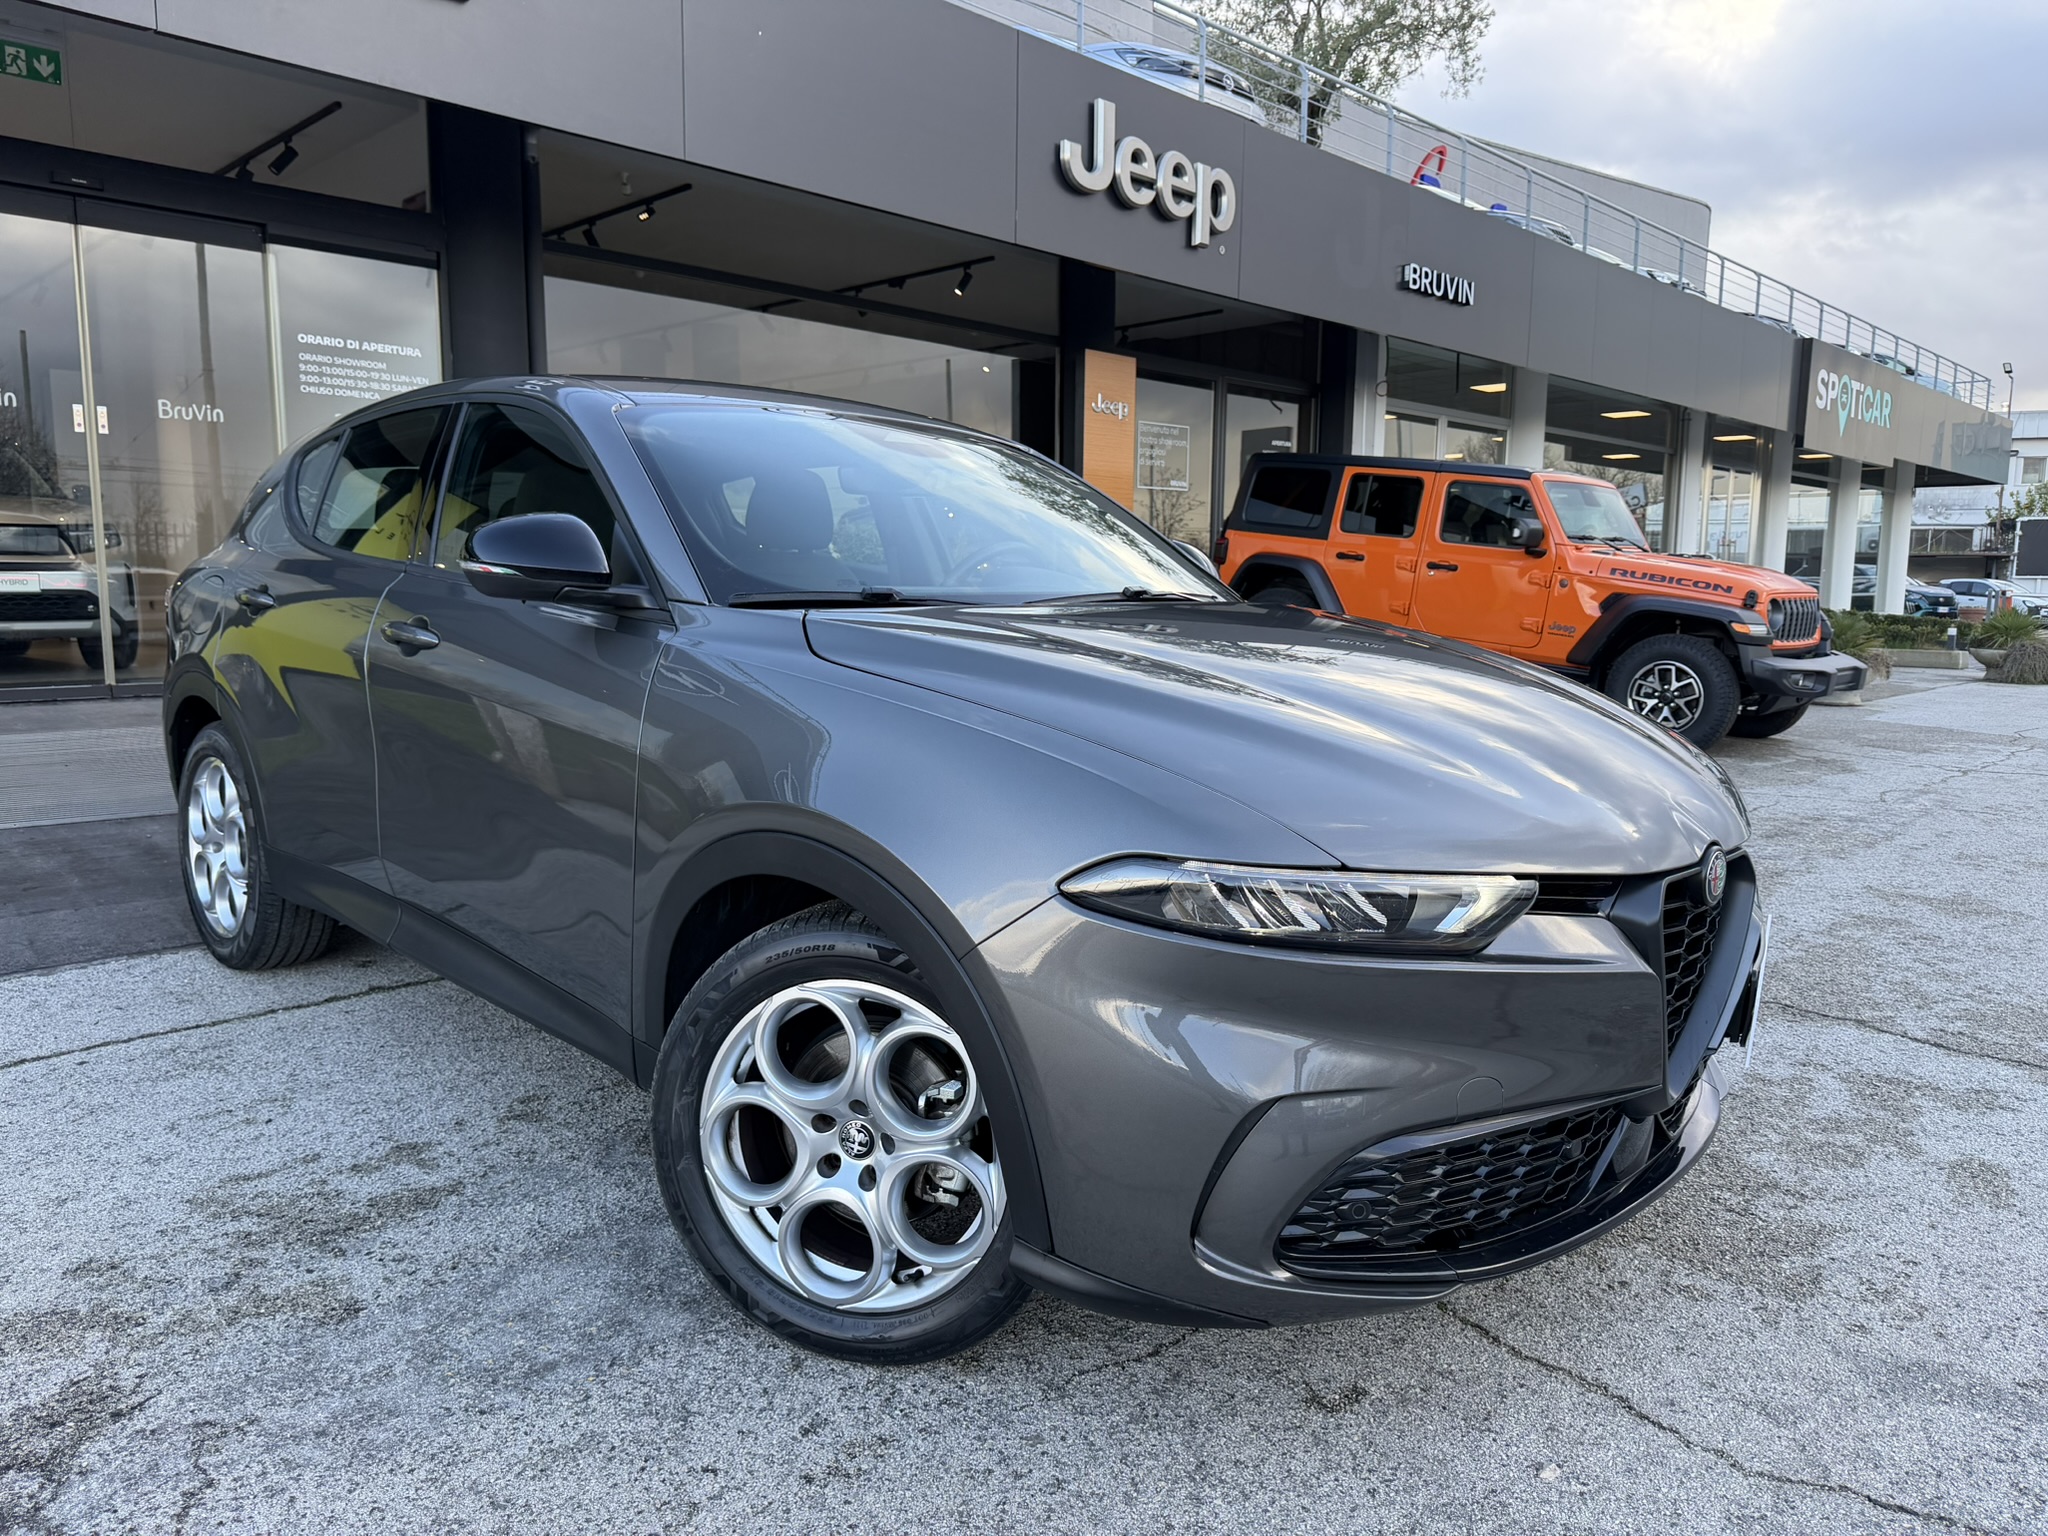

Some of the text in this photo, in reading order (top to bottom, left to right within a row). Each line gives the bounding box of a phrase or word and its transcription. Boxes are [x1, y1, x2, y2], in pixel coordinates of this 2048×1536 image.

[1059, 97, 1236, 249] Jeep
[1408, 262, 1475, 306] BRUVIN
[297, 333, 422, 358] ORARIO DI APERTURA
[299, 352, 387, 370] ORARIO SHOWROOM
[300, 385, 333, 396] CHIUSO
[157, 398, 224, 423] BruVin
[1091, 392, 1129, 420] Jeep
[1609, 567, 1734, 594] RUBICON
[1548, 620, 1577, 635] Jeep
[765, 944, 836, 964] 235/50R18
